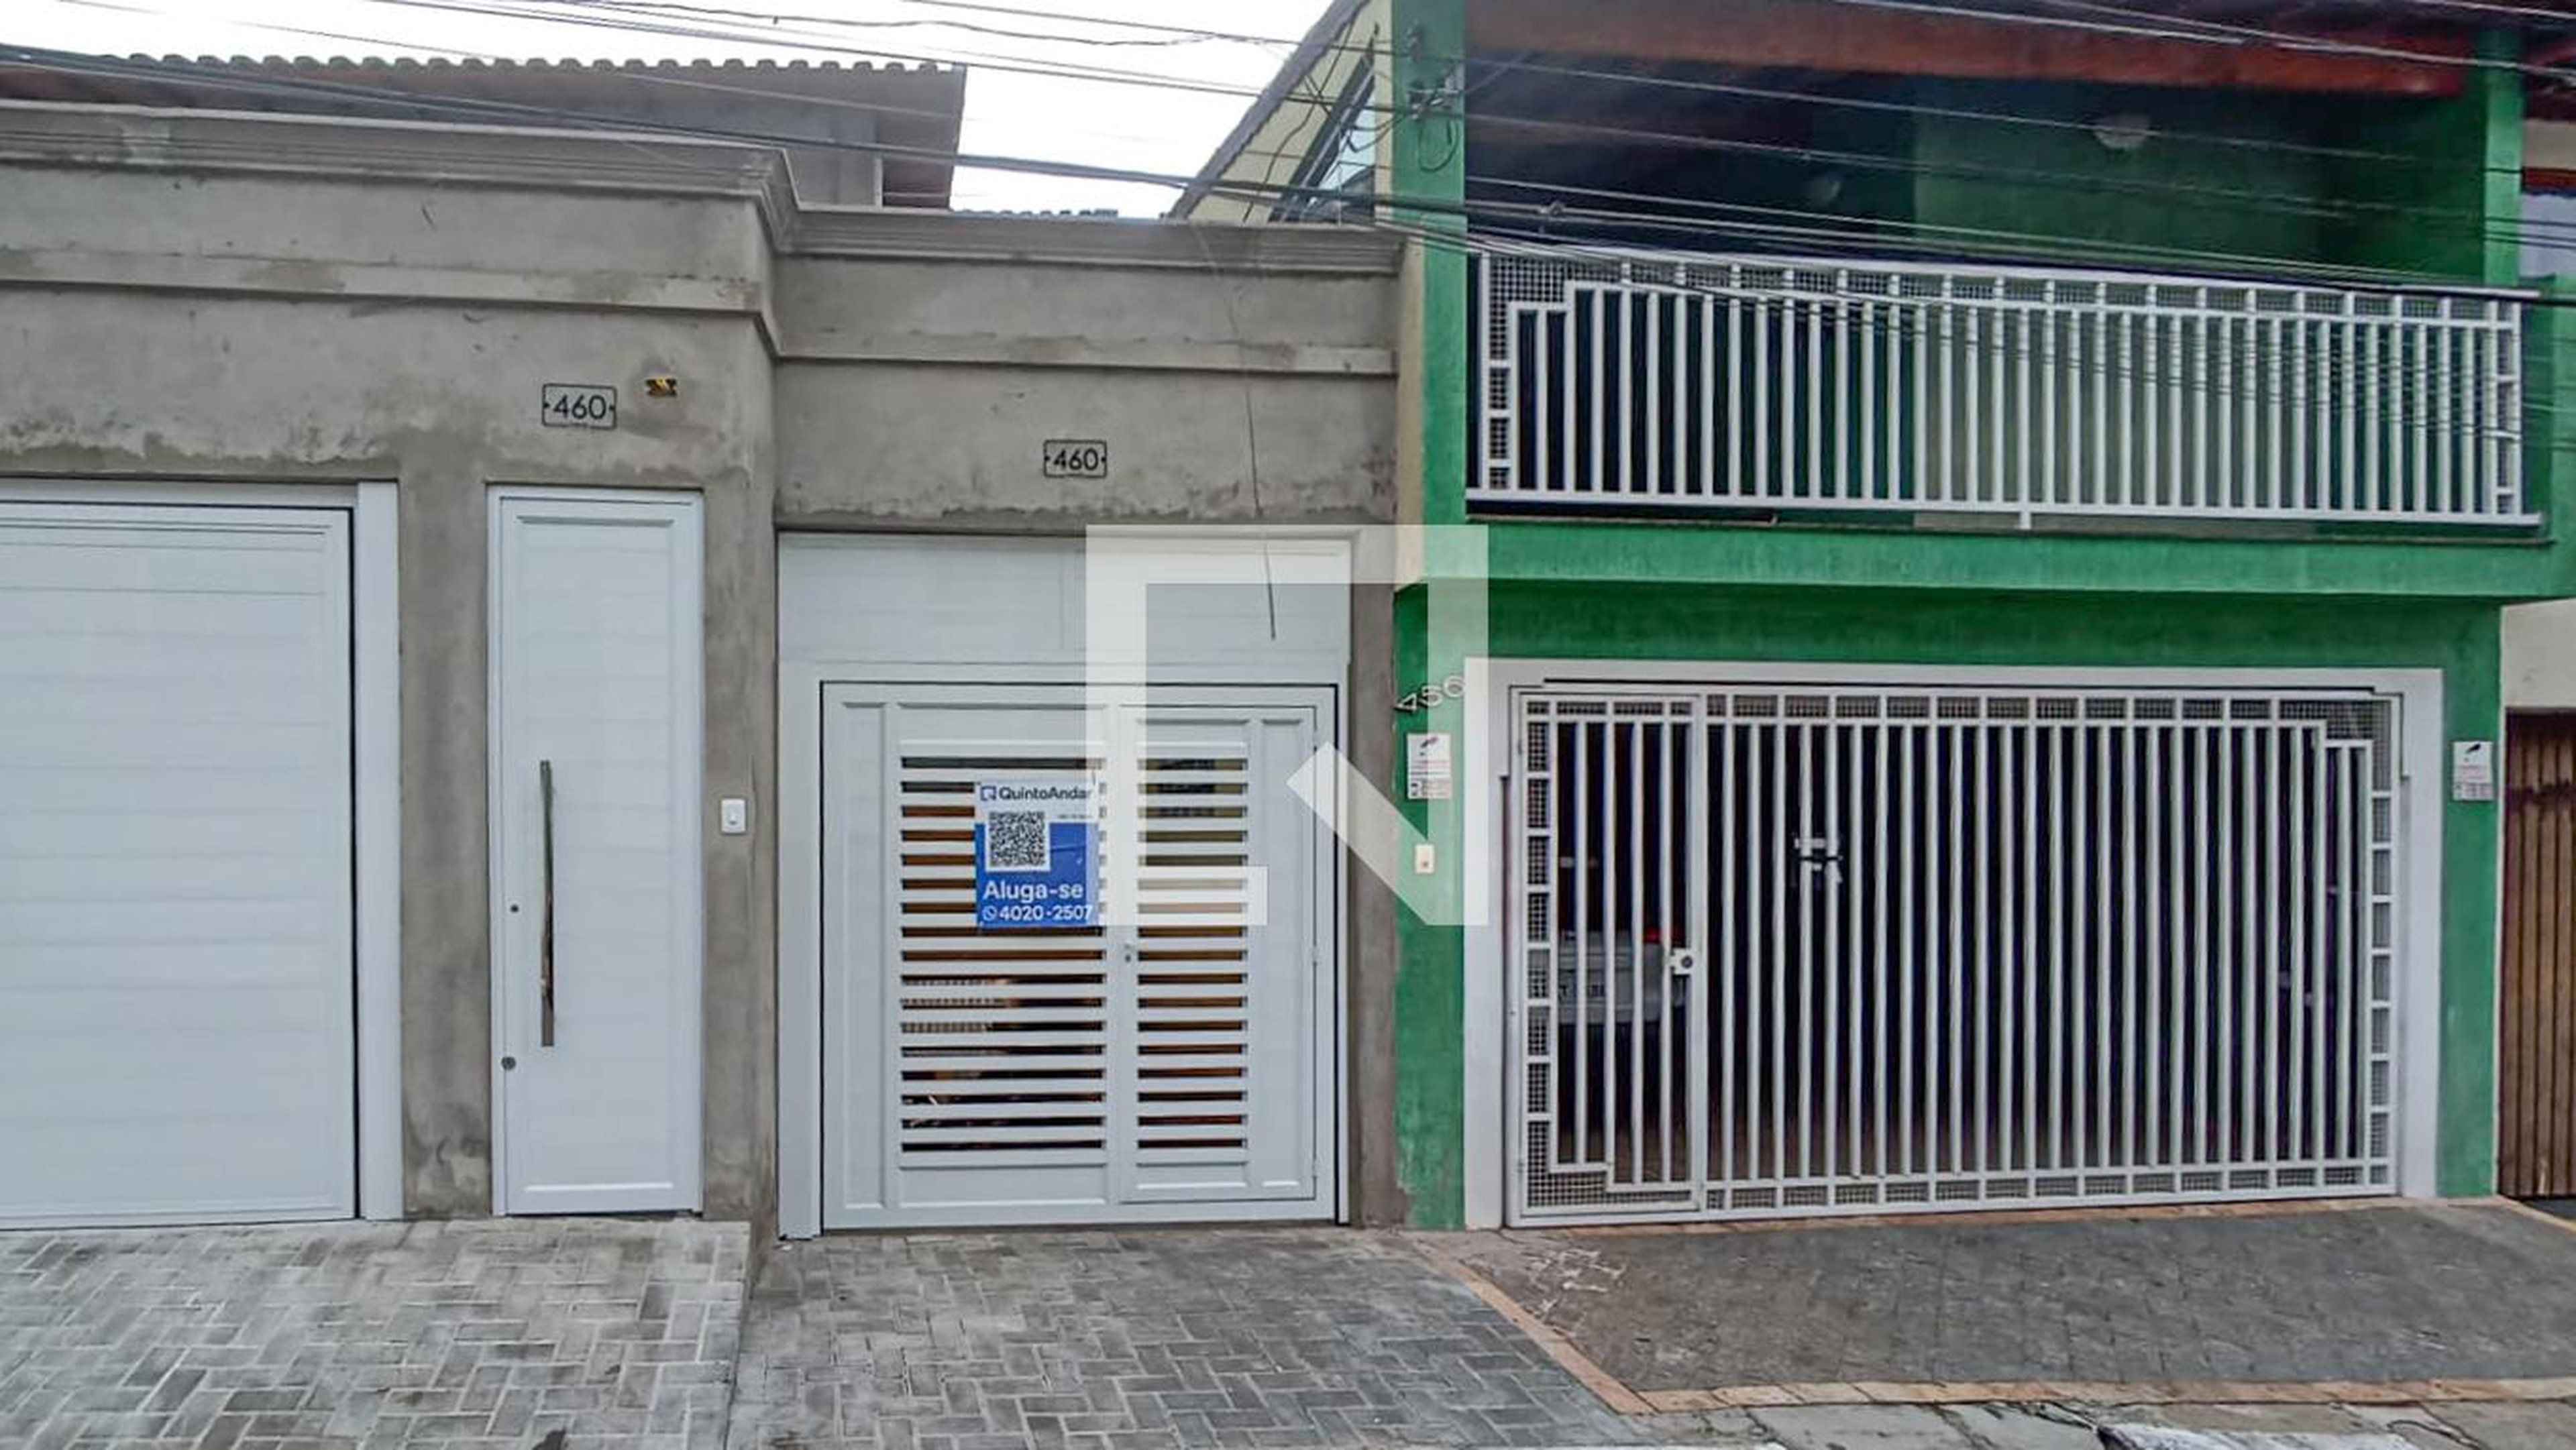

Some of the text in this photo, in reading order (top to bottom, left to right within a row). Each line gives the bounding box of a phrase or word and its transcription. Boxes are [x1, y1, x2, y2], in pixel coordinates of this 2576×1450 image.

[553, 394, 607, 420] 460
[1053, 448, 1099, 471] 460
[1393, 675, 1465, 711] 456
[983, 881, 1084, 902] Aluga-se
